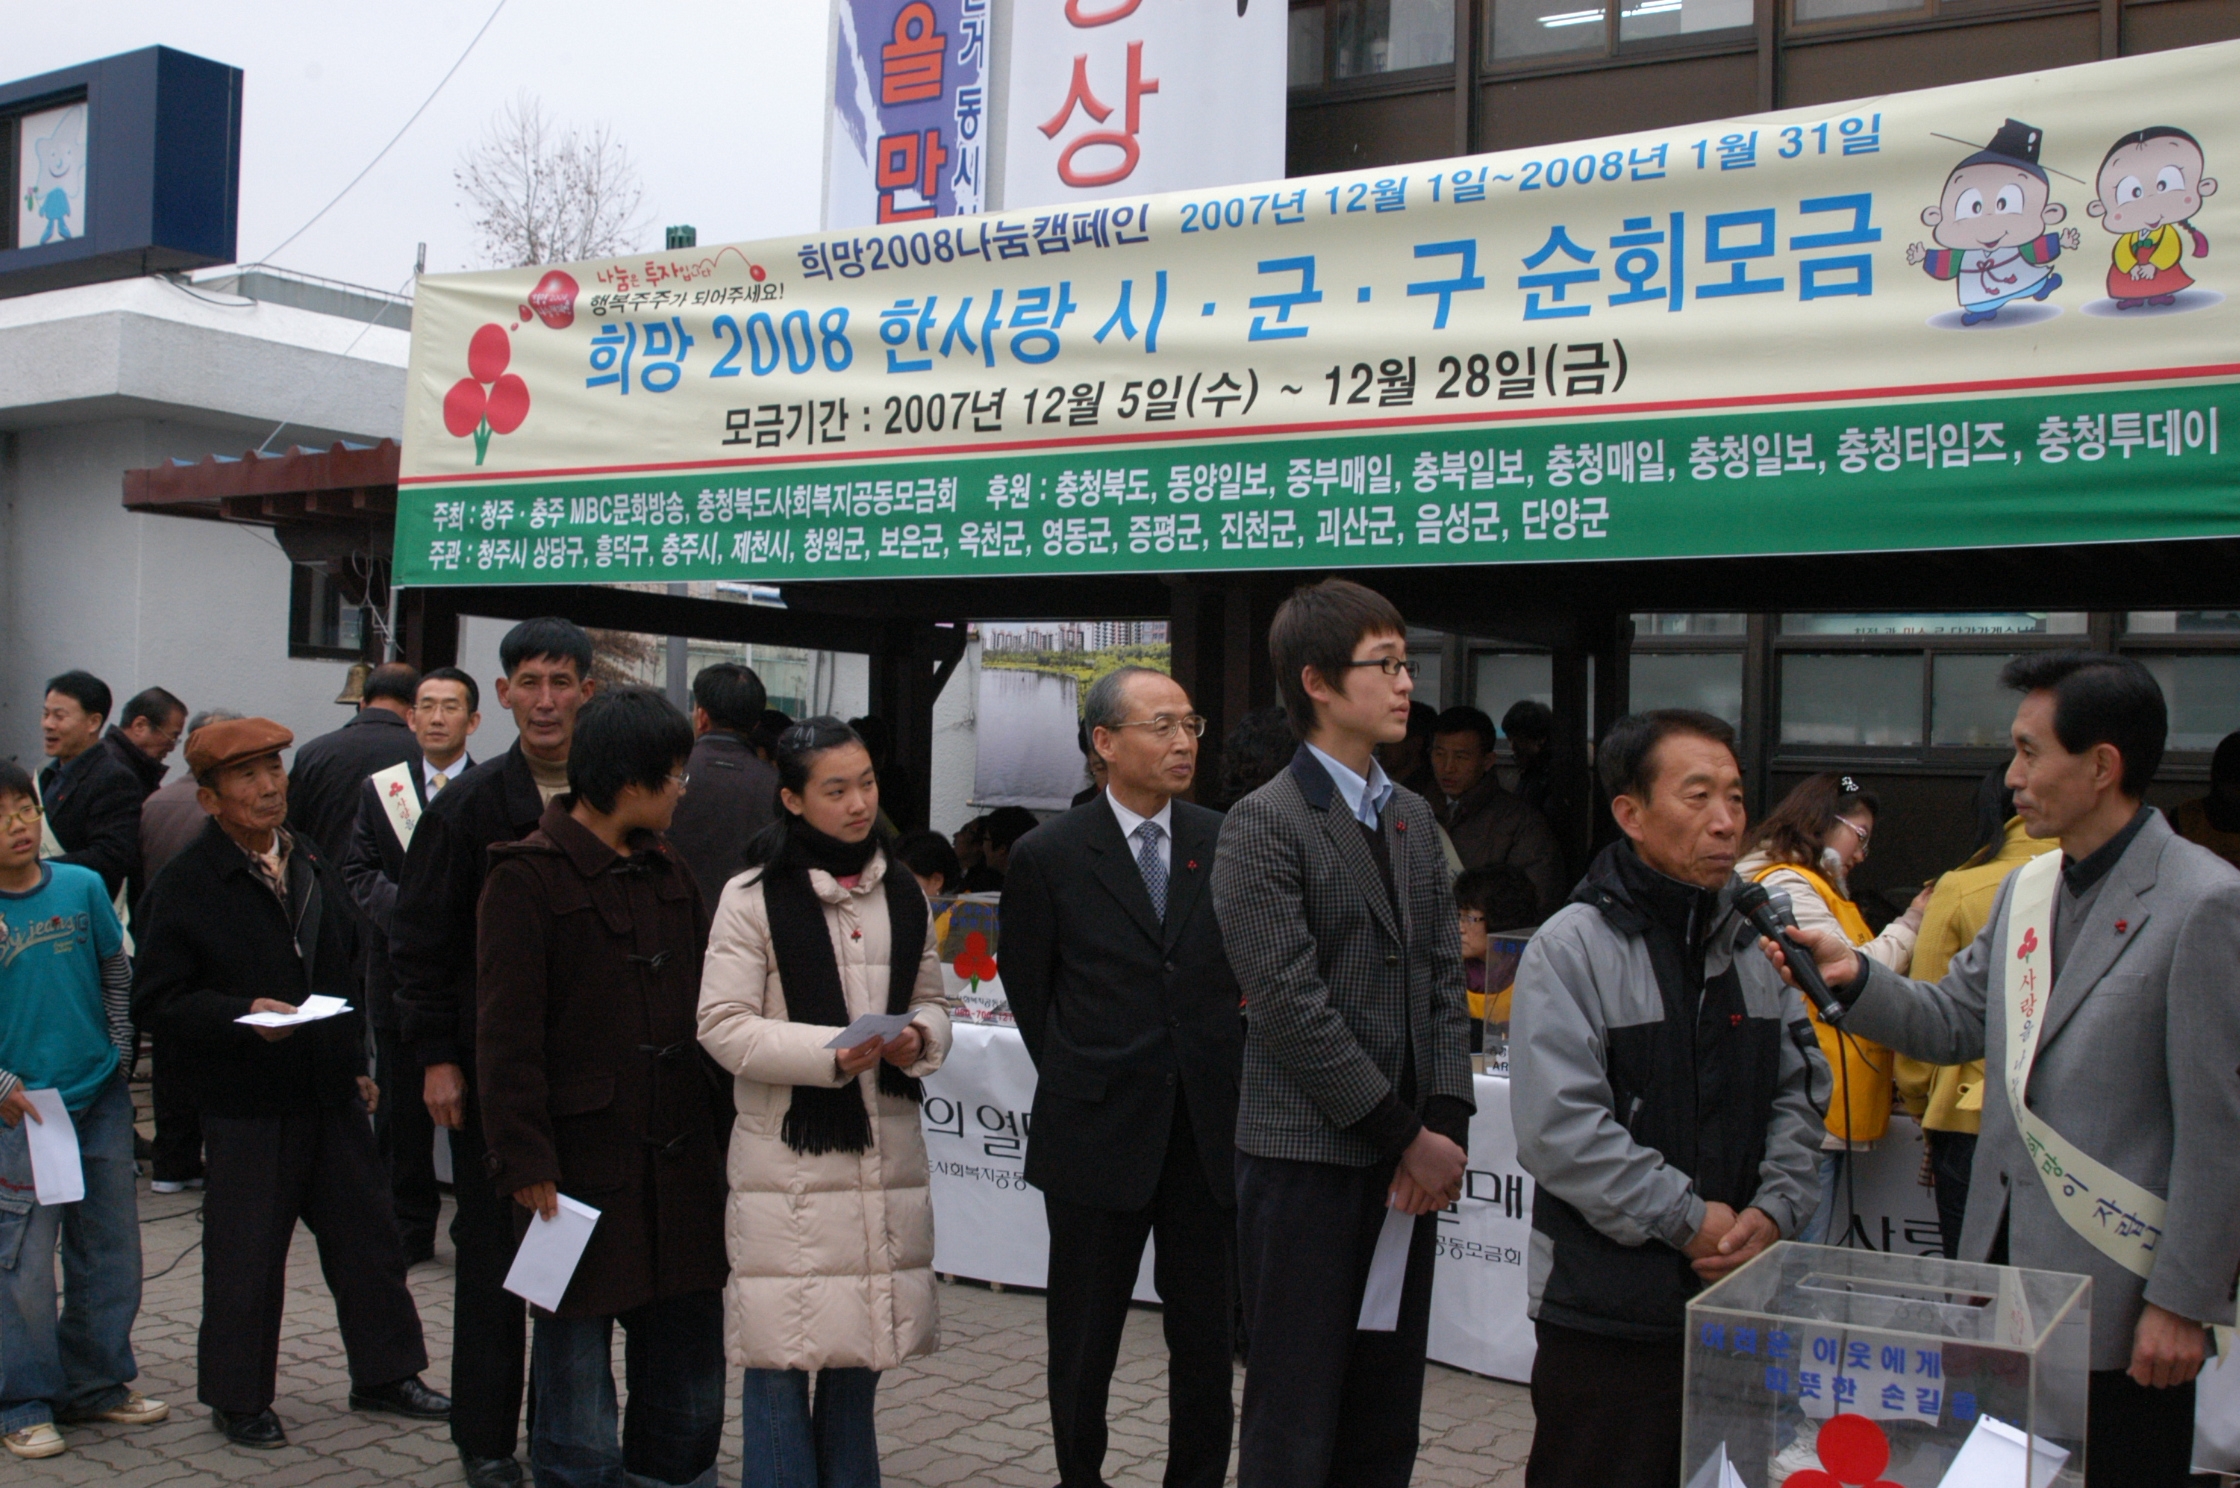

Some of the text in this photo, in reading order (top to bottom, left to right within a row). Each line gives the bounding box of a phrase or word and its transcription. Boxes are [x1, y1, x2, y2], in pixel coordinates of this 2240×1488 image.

[1180, 188, 1307, 234] 2007년
[1325, 176, 1409, 215] 12월
[1691, 130, 1759, 171] 1월
[1778, 113, 1881, 159] 31일
[597, 264, 640, 293] 나눔은
[797, 203, 1150, 281] 희망2008나눔캠페인
[586, 315, 695, 396] 희망
[709, 306, 854, 379] 2008
[878, 280, 1077, 374] 한사랑
[1518, 192, 1882, 322] 순회모금
[590, 282, 785, 317] 행복주주가 되어주세요!
[721, 398, 850, 449] 모금기간
[884, 386, 1007, 435] 2007년
[1023, 381, 1106, 428] 12월
[1117, 367, 1259, 422] 5일(수)
[1325, 356, 1416, 408] 12월
[1436, 338, 1628, 401] 28일(금)
[432, 501, 465, 532] 주최
[480, 499, 515, 531] 청주
[530, 497, 565, 529] 충주
[570, 491, 691, 526] MBC문화방송,
[697, 476, 958, 524] 충청북도사회복지공동모금회
[985, 472, 1032, 511] 후원
[1055, 467, 1157, 508] 충청북도,
[1167, 461, 1276, 504] 동양일보,
[1286, 453, 1402, 500] 중부매일,
[1411, 447, 1534, 494] 충북일보,
[1545, 438, 1676, 489] 충청매일,
[1688, 431, 1826, 480] 충청일보,
[1836, 420, 2022, 473] 충청타임즈,
[2036, 406, 2218, 464] 충청투데이
[428, 539, 461, 571] 주관
[477, 537, 528, 570] 청주시
[533, 535, 589, 569] 상당구,
[595, 534, 654, 568] 흥덕구,
[661, 532, 723, 566] 충주시,
[730, 528, 795, 564] 제천시,
[803, 526, 870, 563] 청원군,
[878, 523, 949, 560] 보은군,
[958, 519, 1032, 558] 옥천군,
[1042, 516, 1118, 556] 영동군,
[1128, 513, 1209, 554] 증평군,
[1220, 509, 1304, 549] 진천군,
[1316, 504, 1404, 547] 괴산군,
[1415, 501, 1509, 546] 음성군,
[1522, 496, 1610, 540] 단양군
[1812, 1336, 1942, 1379] 이웃에게
